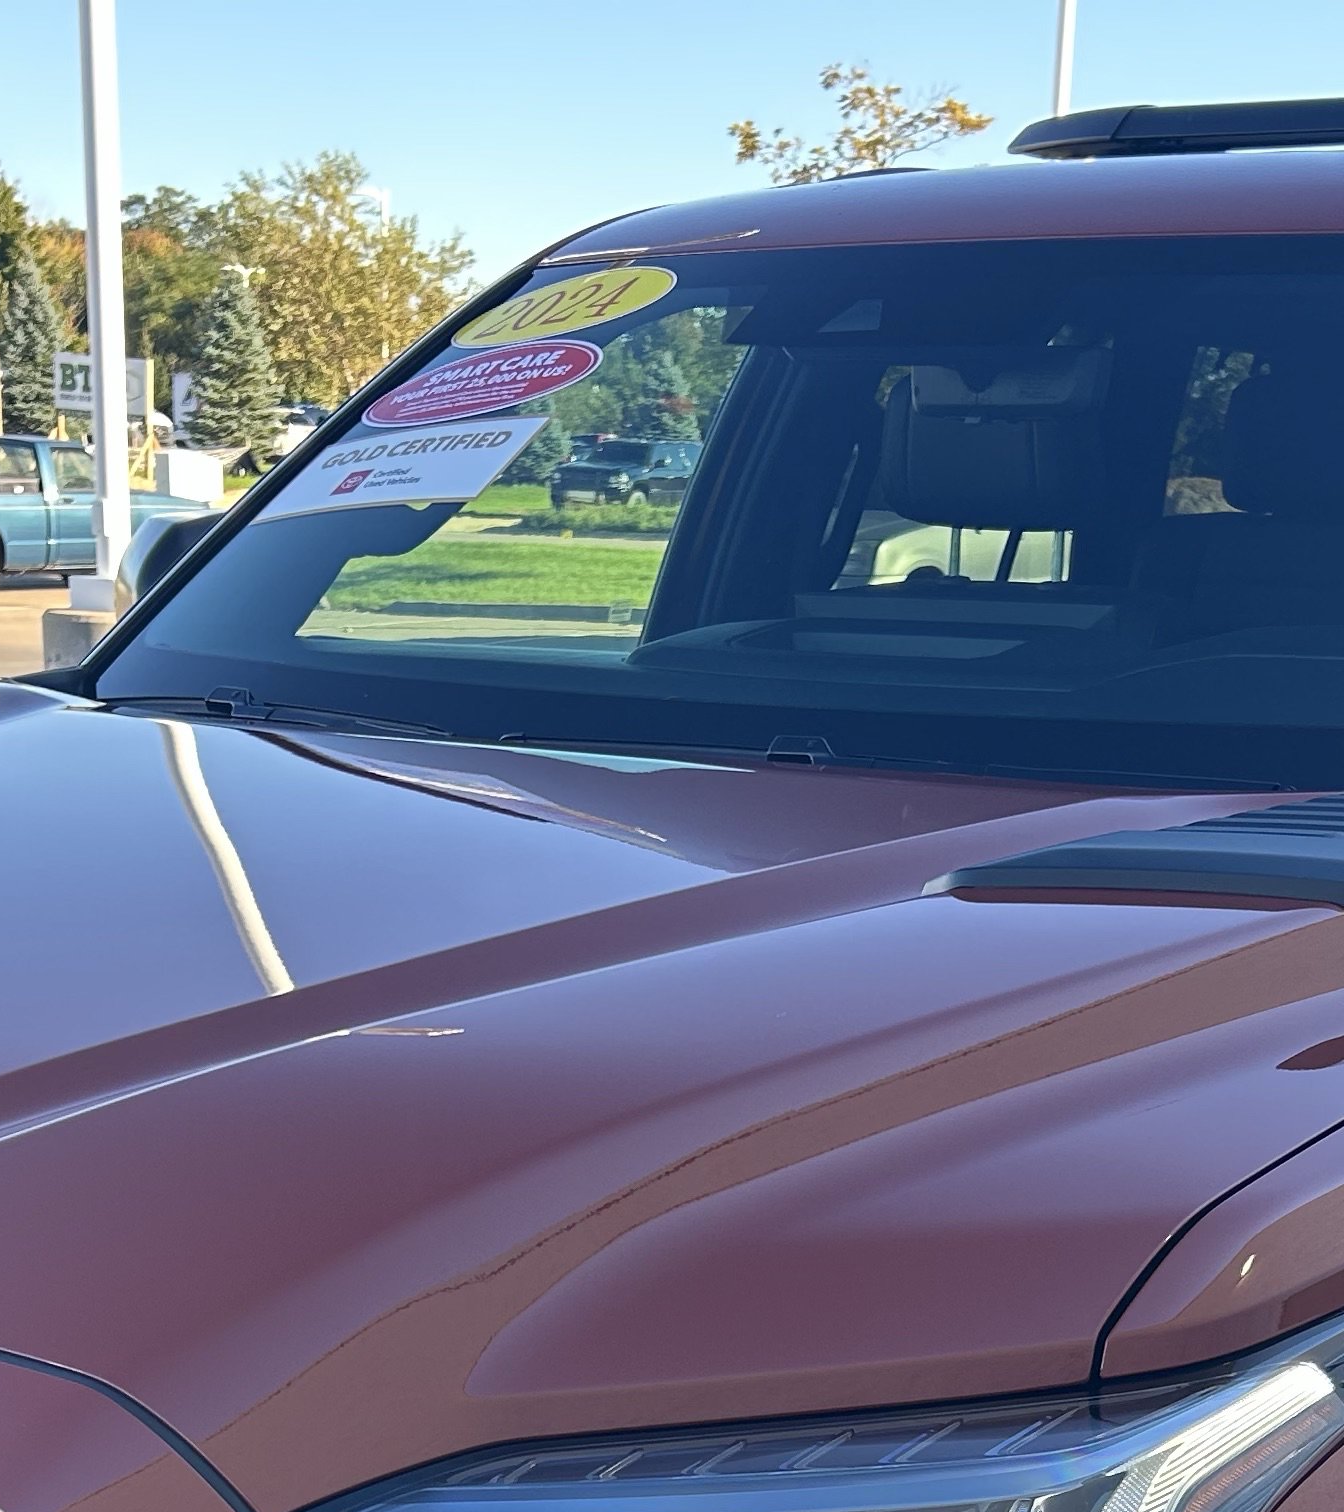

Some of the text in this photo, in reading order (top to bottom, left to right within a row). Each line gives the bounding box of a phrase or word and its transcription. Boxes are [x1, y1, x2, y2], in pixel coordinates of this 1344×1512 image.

[471, 277, 640, 341] 2024
[423, 350, 566, 388] SMART CARE
[321, 431, 513, 470] GOLD CERTIFIED
